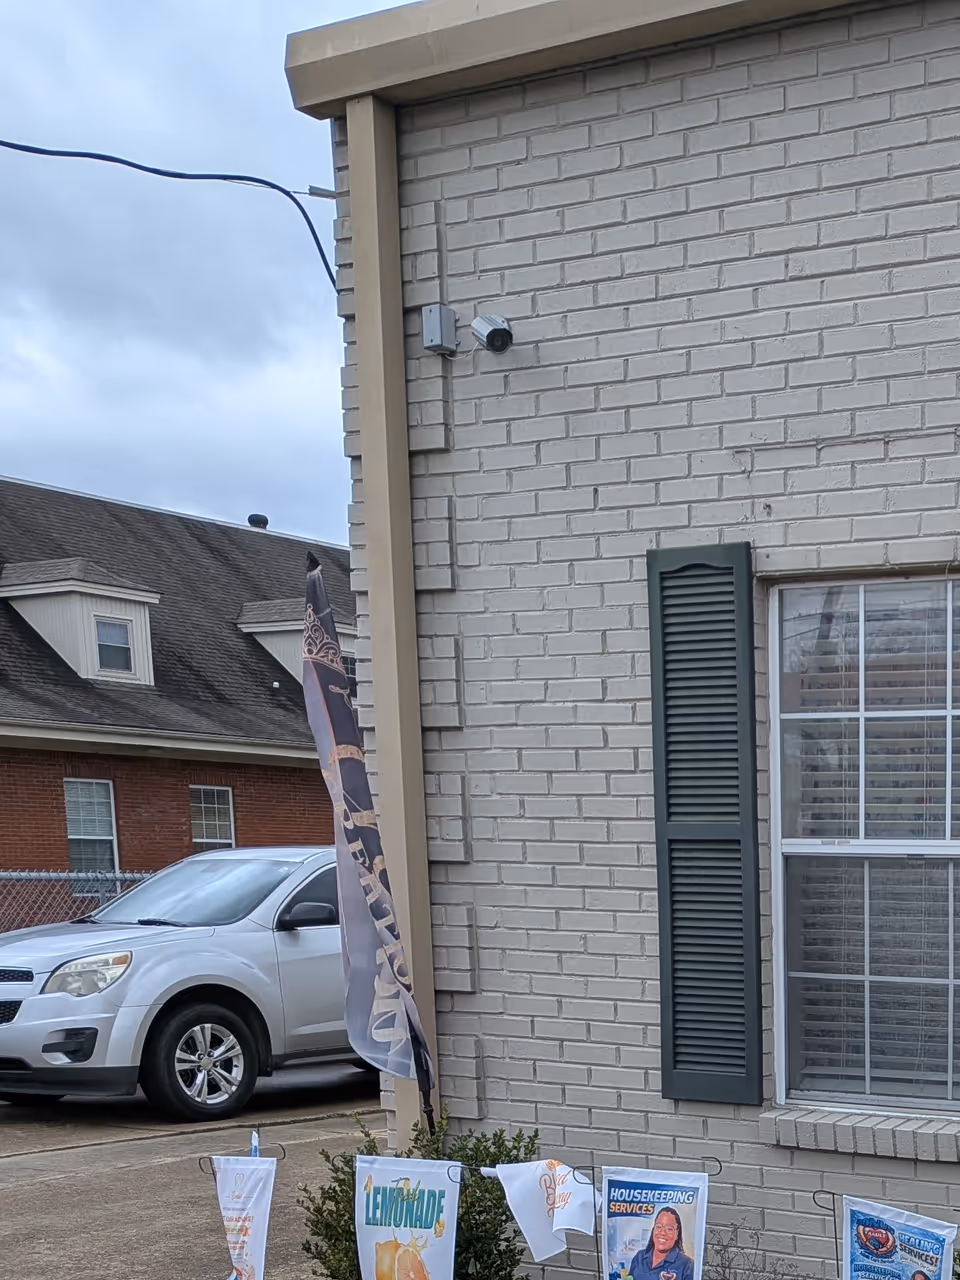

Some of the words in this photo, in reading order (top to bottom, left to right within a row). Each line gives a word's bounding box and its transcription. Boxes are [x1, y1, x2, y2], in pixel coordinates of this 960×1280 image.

[610, 1187, 694, 1204] HOUSEKEEPING
[365, 1186, 446, 1229] LEMONADE
[609, 1201, 655, 1214] SERVICES
[898, 1244, 940, 1267] SERVICES!
[854, 1263, 902, 1280] HOUSEKEEPING
